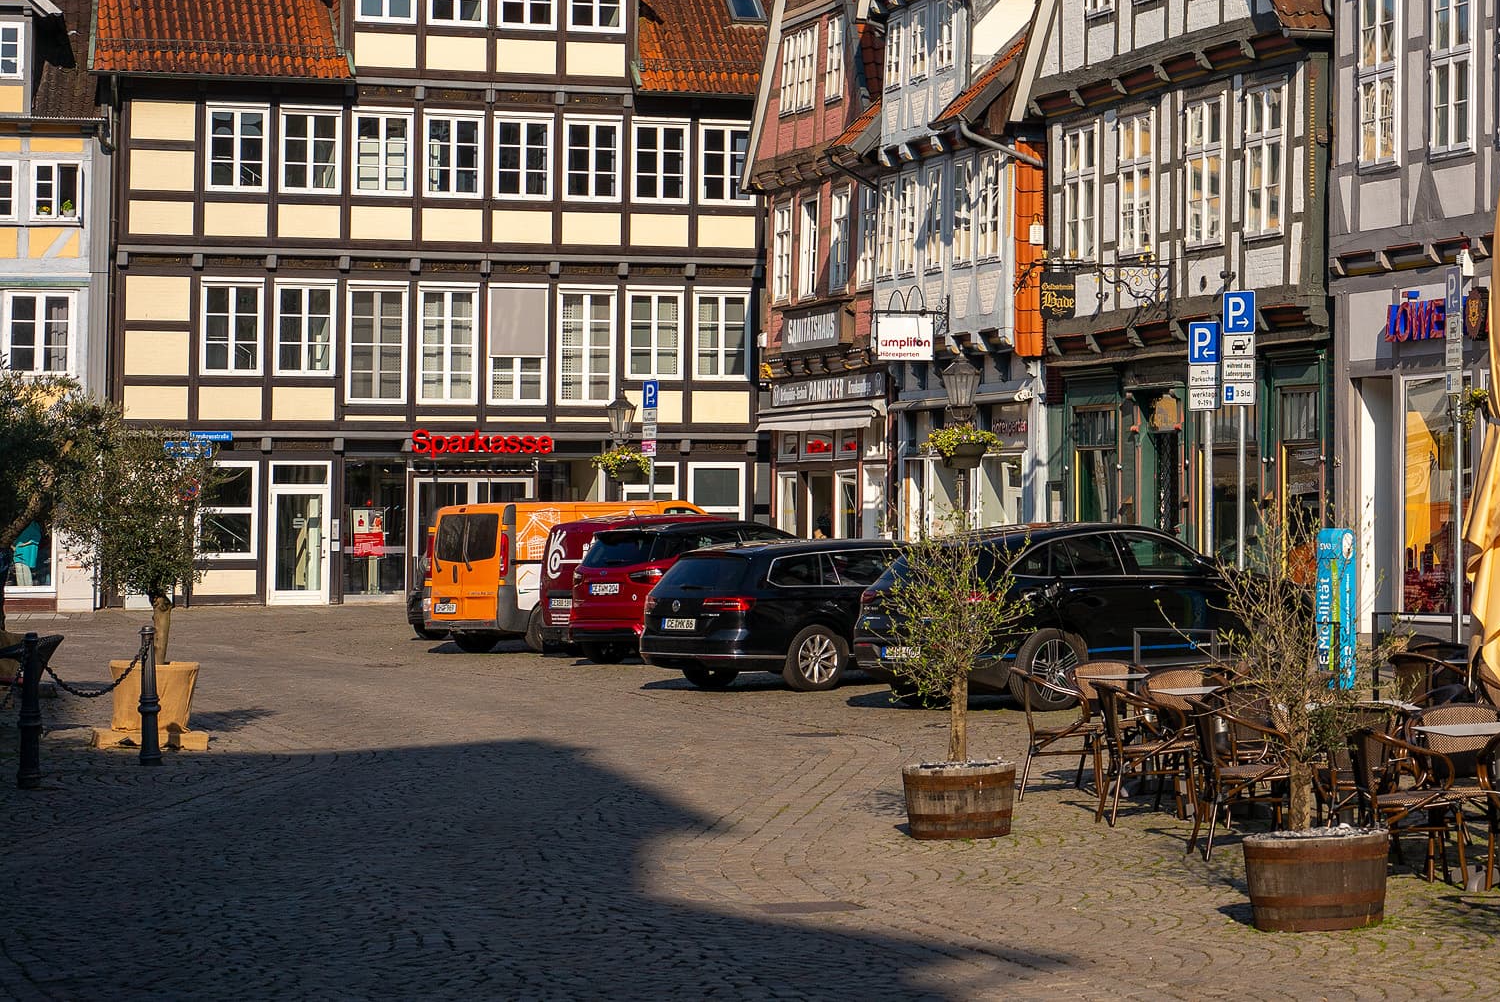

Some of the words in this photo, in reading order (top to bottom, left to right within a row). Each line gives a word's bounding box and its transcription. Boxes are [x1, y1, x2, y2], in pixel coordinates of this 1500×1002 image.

[1041, 291, 1075, 309] Bade
[1228, 297, 1246, 328] P
[880, 337, 931, 349] amplifon
[1194, 327, 1212, 358] P
[1225, 370, 1252, 378] Ladevorgangs
[1192, 391, 1218, 400] werktags
[411, 428, 553, 459] Sparkasse
